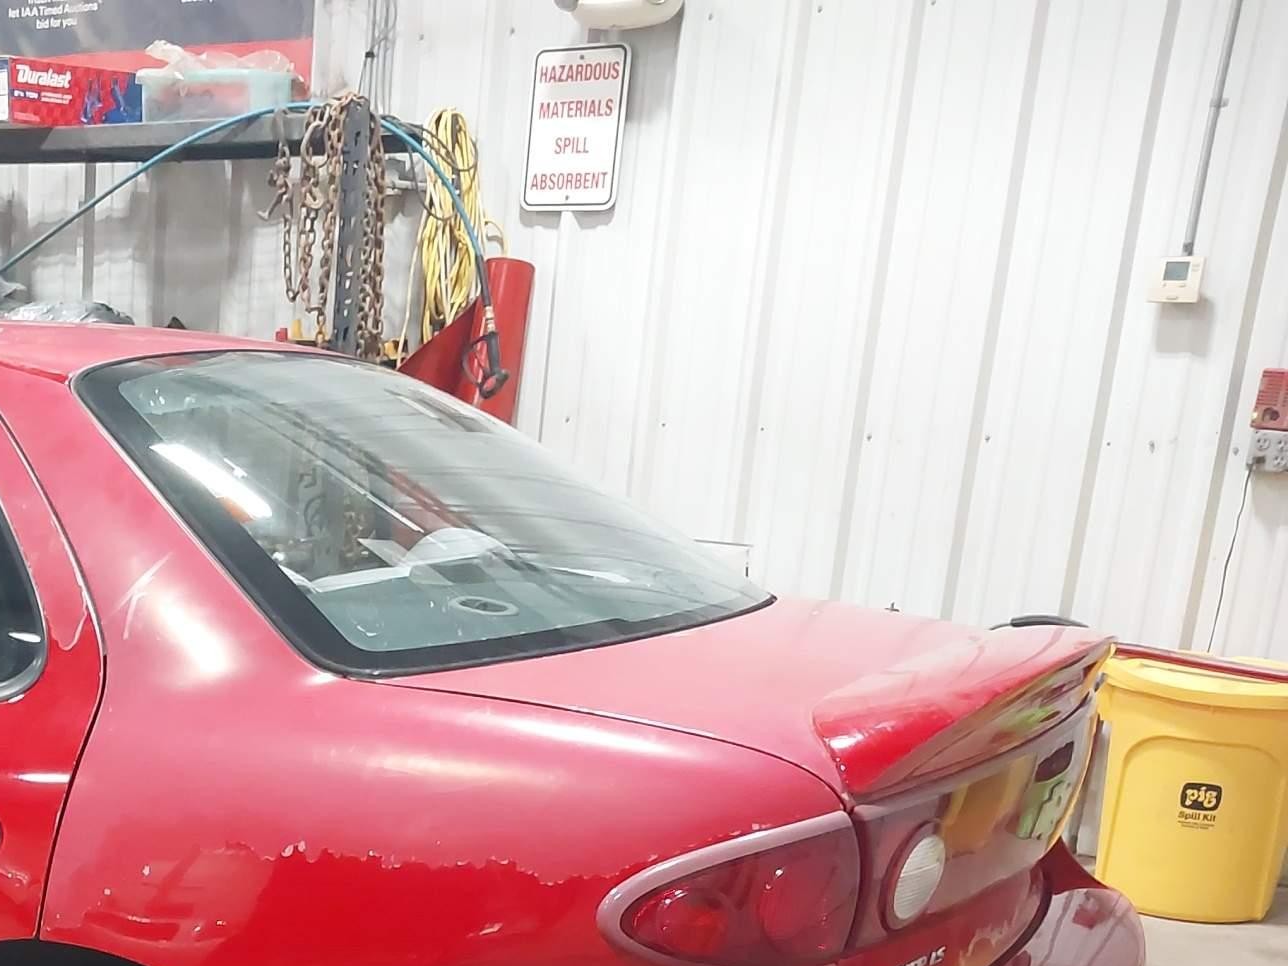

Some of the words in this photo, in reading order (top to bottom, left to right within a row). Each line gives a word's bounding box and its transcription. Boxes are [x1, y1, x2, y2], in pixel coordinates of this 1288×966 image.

[21, 7, 38, 17] IAA
[36, 19, 49, 29] bid
[50, 18, 61, 28] for
[15, 64, 72, 89] Duralast
[539, 61, 620, 83] HAZARDOUS
[538, 98, 614, 120] MATERIALS
[554, 136, 589, 154] SPILL
[530, 172, 608, 190] ABSORBENT
[1185, 786, 1218, 808] pig
